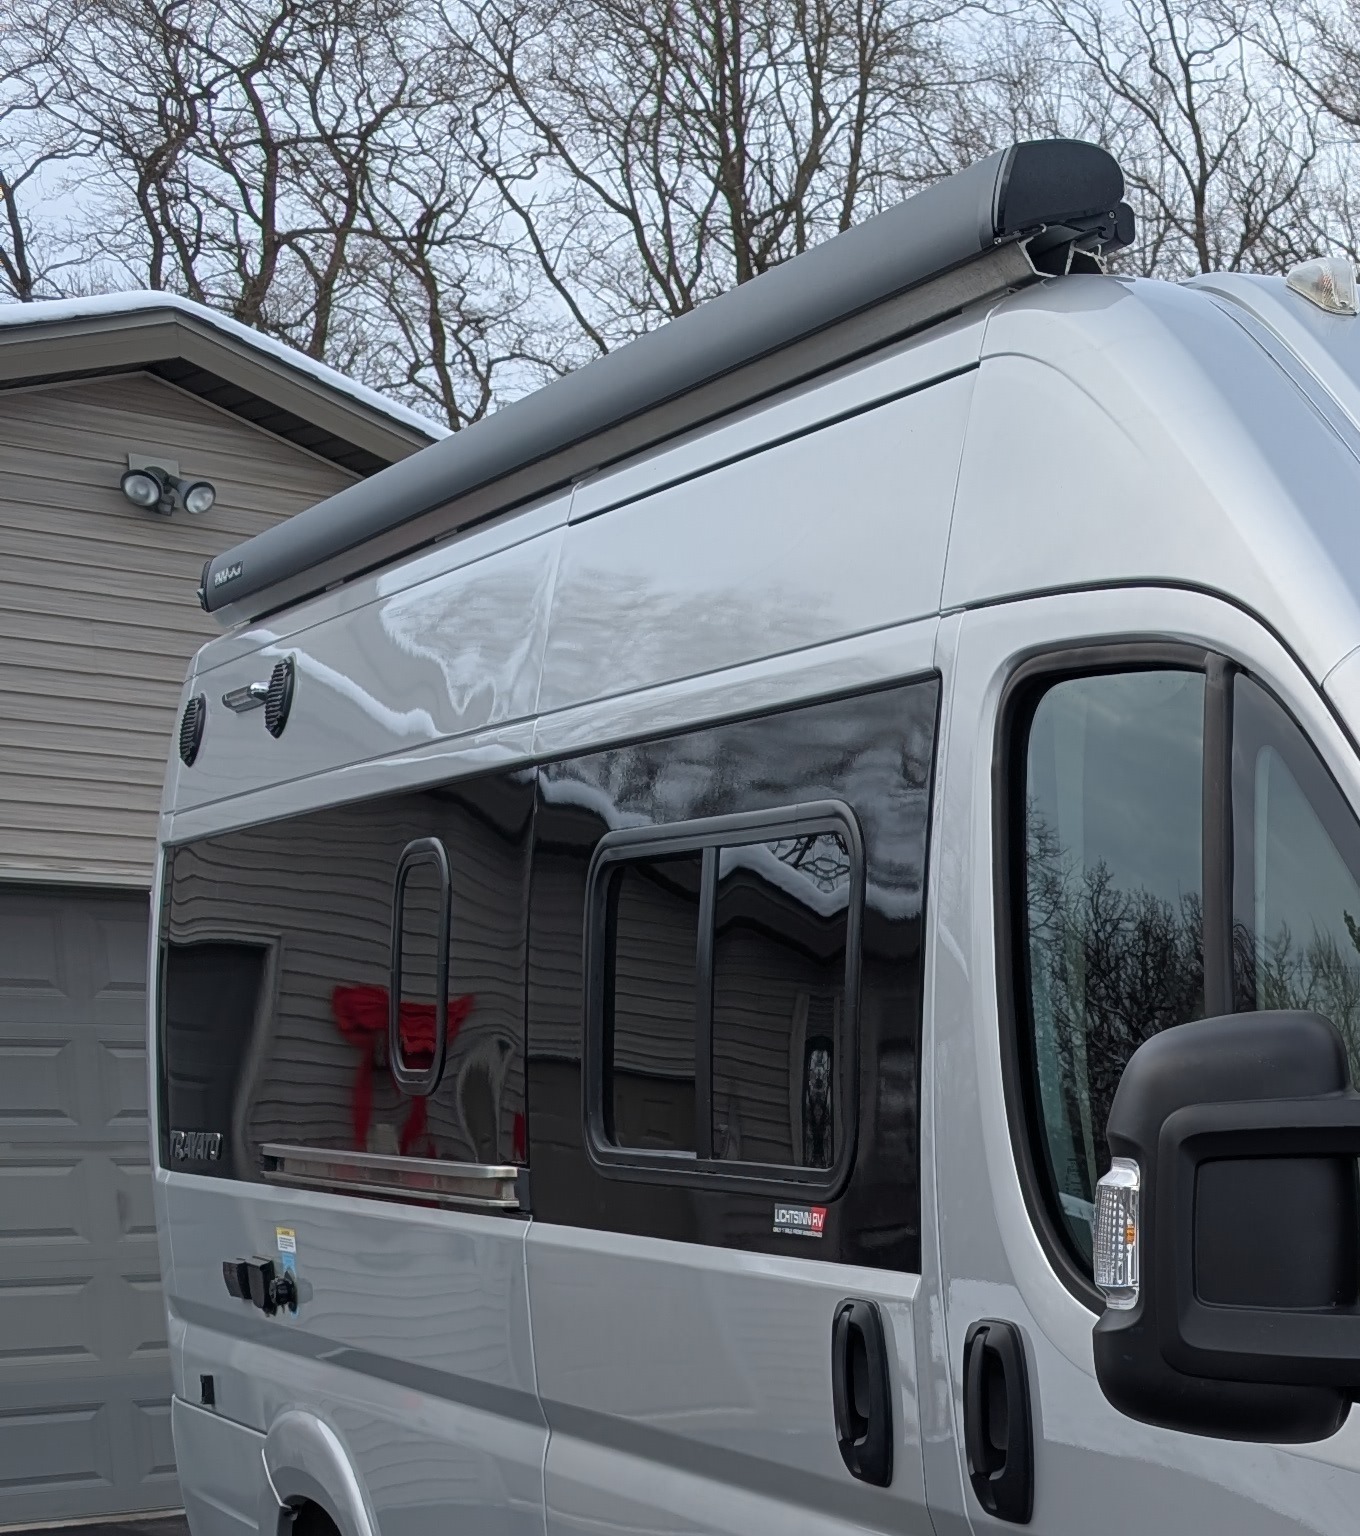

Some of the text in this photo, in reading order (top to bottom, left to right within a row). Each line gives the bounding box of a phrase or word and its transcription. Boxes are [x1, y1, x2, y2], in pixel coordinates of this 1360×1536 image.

[170, 1129, 223, 1161] TRAVATO
[775, 1208, 824, 1228] LICHTSINN RV
